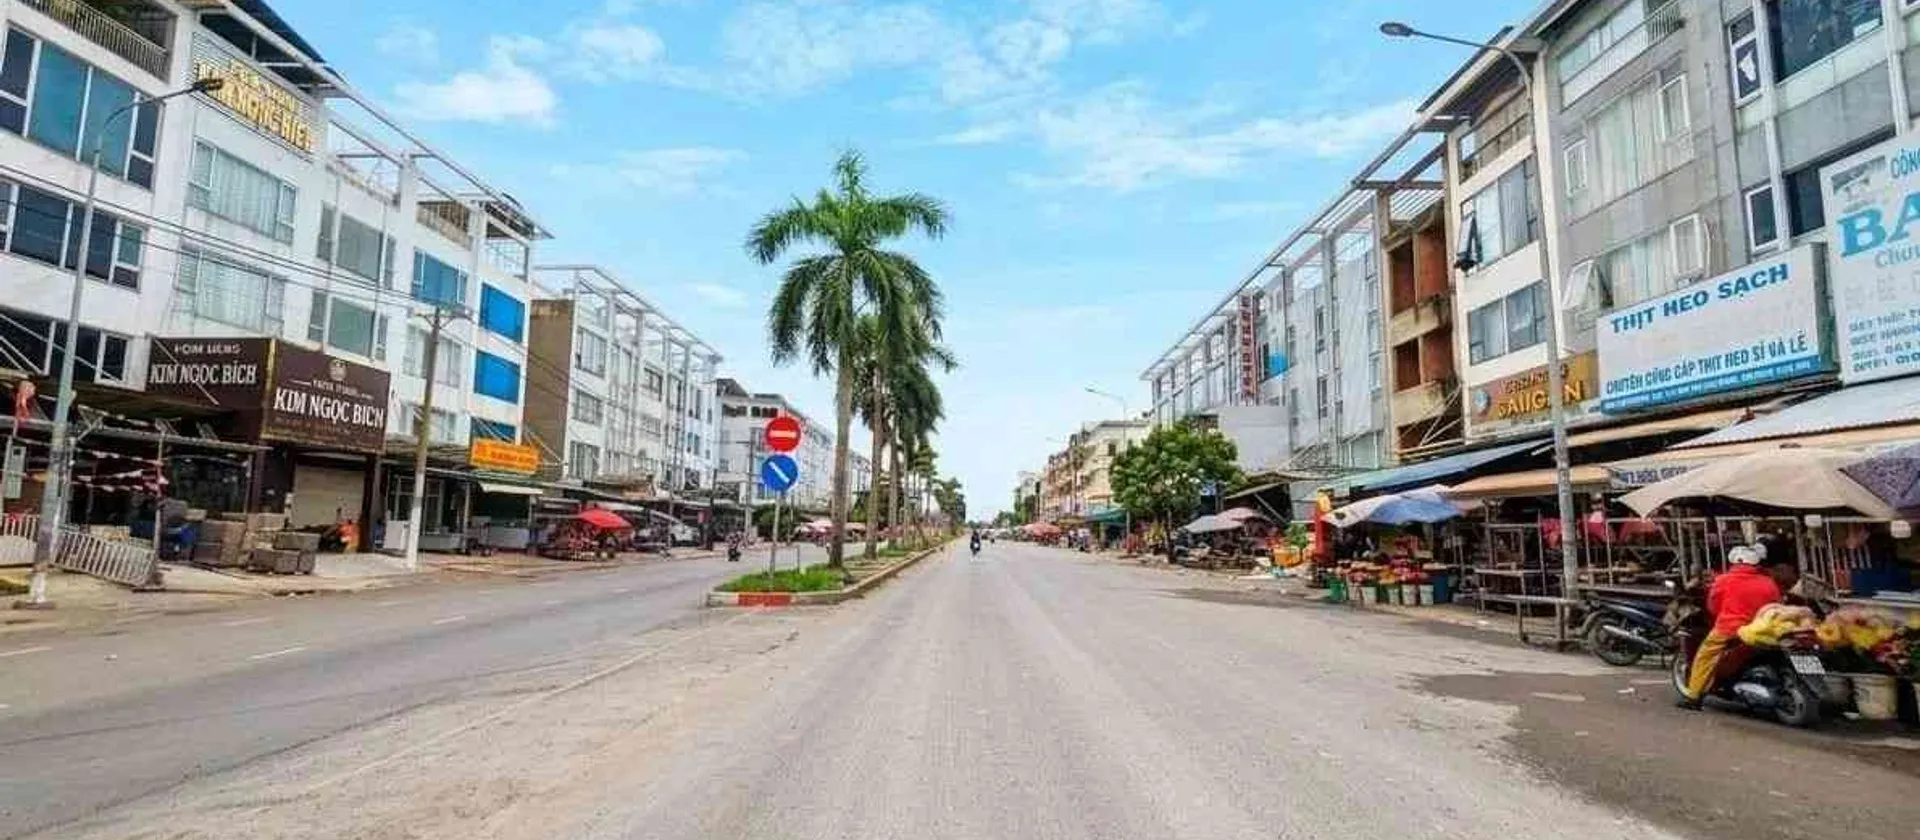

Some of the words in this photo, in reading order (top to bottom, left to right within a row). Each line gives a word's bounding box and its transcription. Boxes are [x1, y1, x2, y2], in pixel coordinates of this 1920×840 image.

[1611, 306, 1656, 334] THỊT
[1663, 290, 1710, 318] HEO
[1717, 263, 1790, 299] SẠCH
[1724, 348, 1750, 369] HEO
[308, 394, 350, 426] NGỌC
